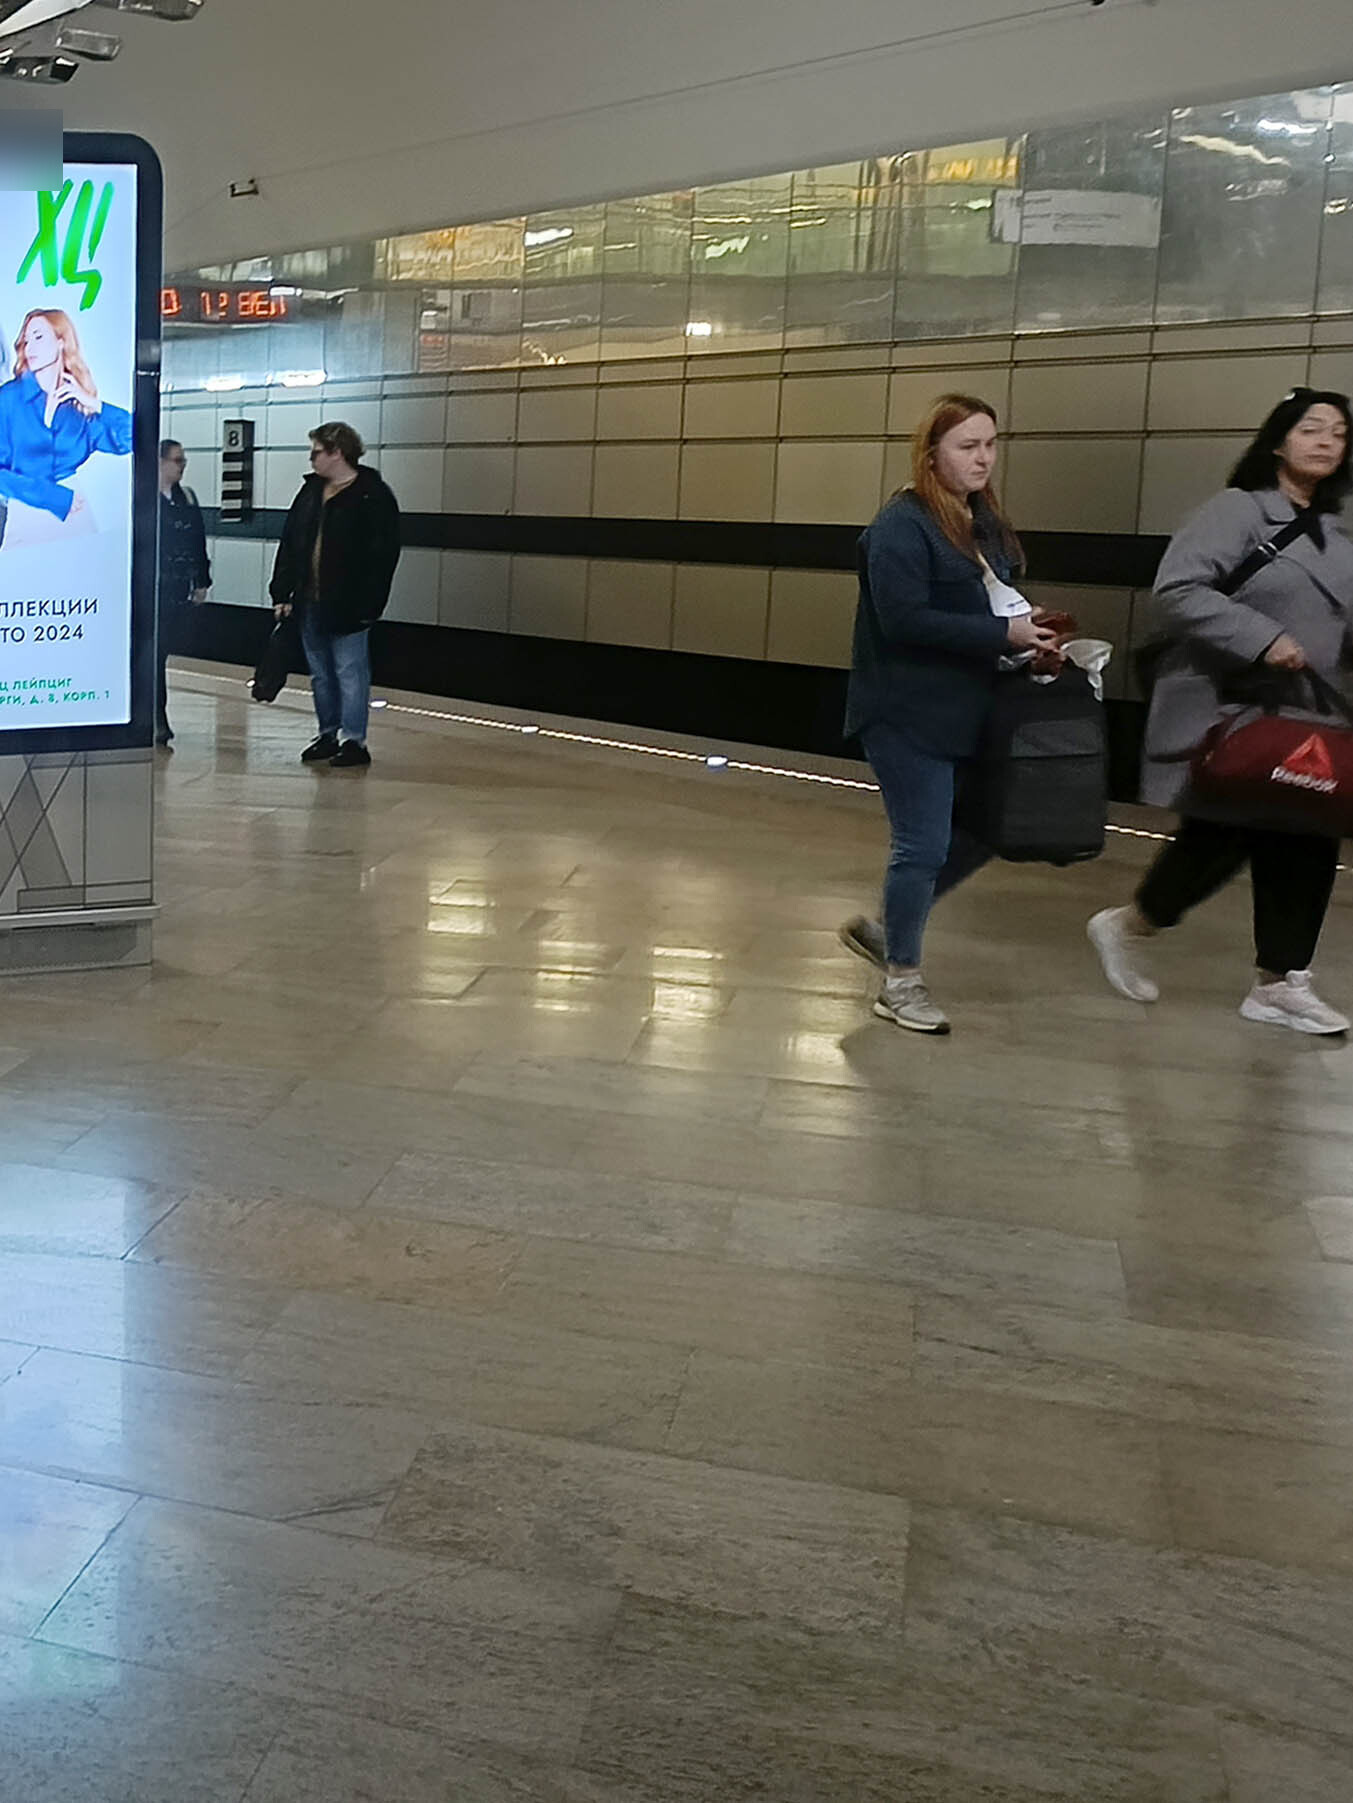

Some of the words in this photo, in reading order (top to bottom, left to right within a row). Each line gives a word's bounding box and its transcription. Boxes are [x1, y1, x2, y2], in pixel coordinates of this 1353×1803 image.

[228, 430, 240, 447] 8
[32, 623, 85, 642] 2024
[12, 677, 73, 691] ЛЕЙПЦИГ
[62, 689, 101, 702] КОРП.
[104, 689, 110, 699] 1
